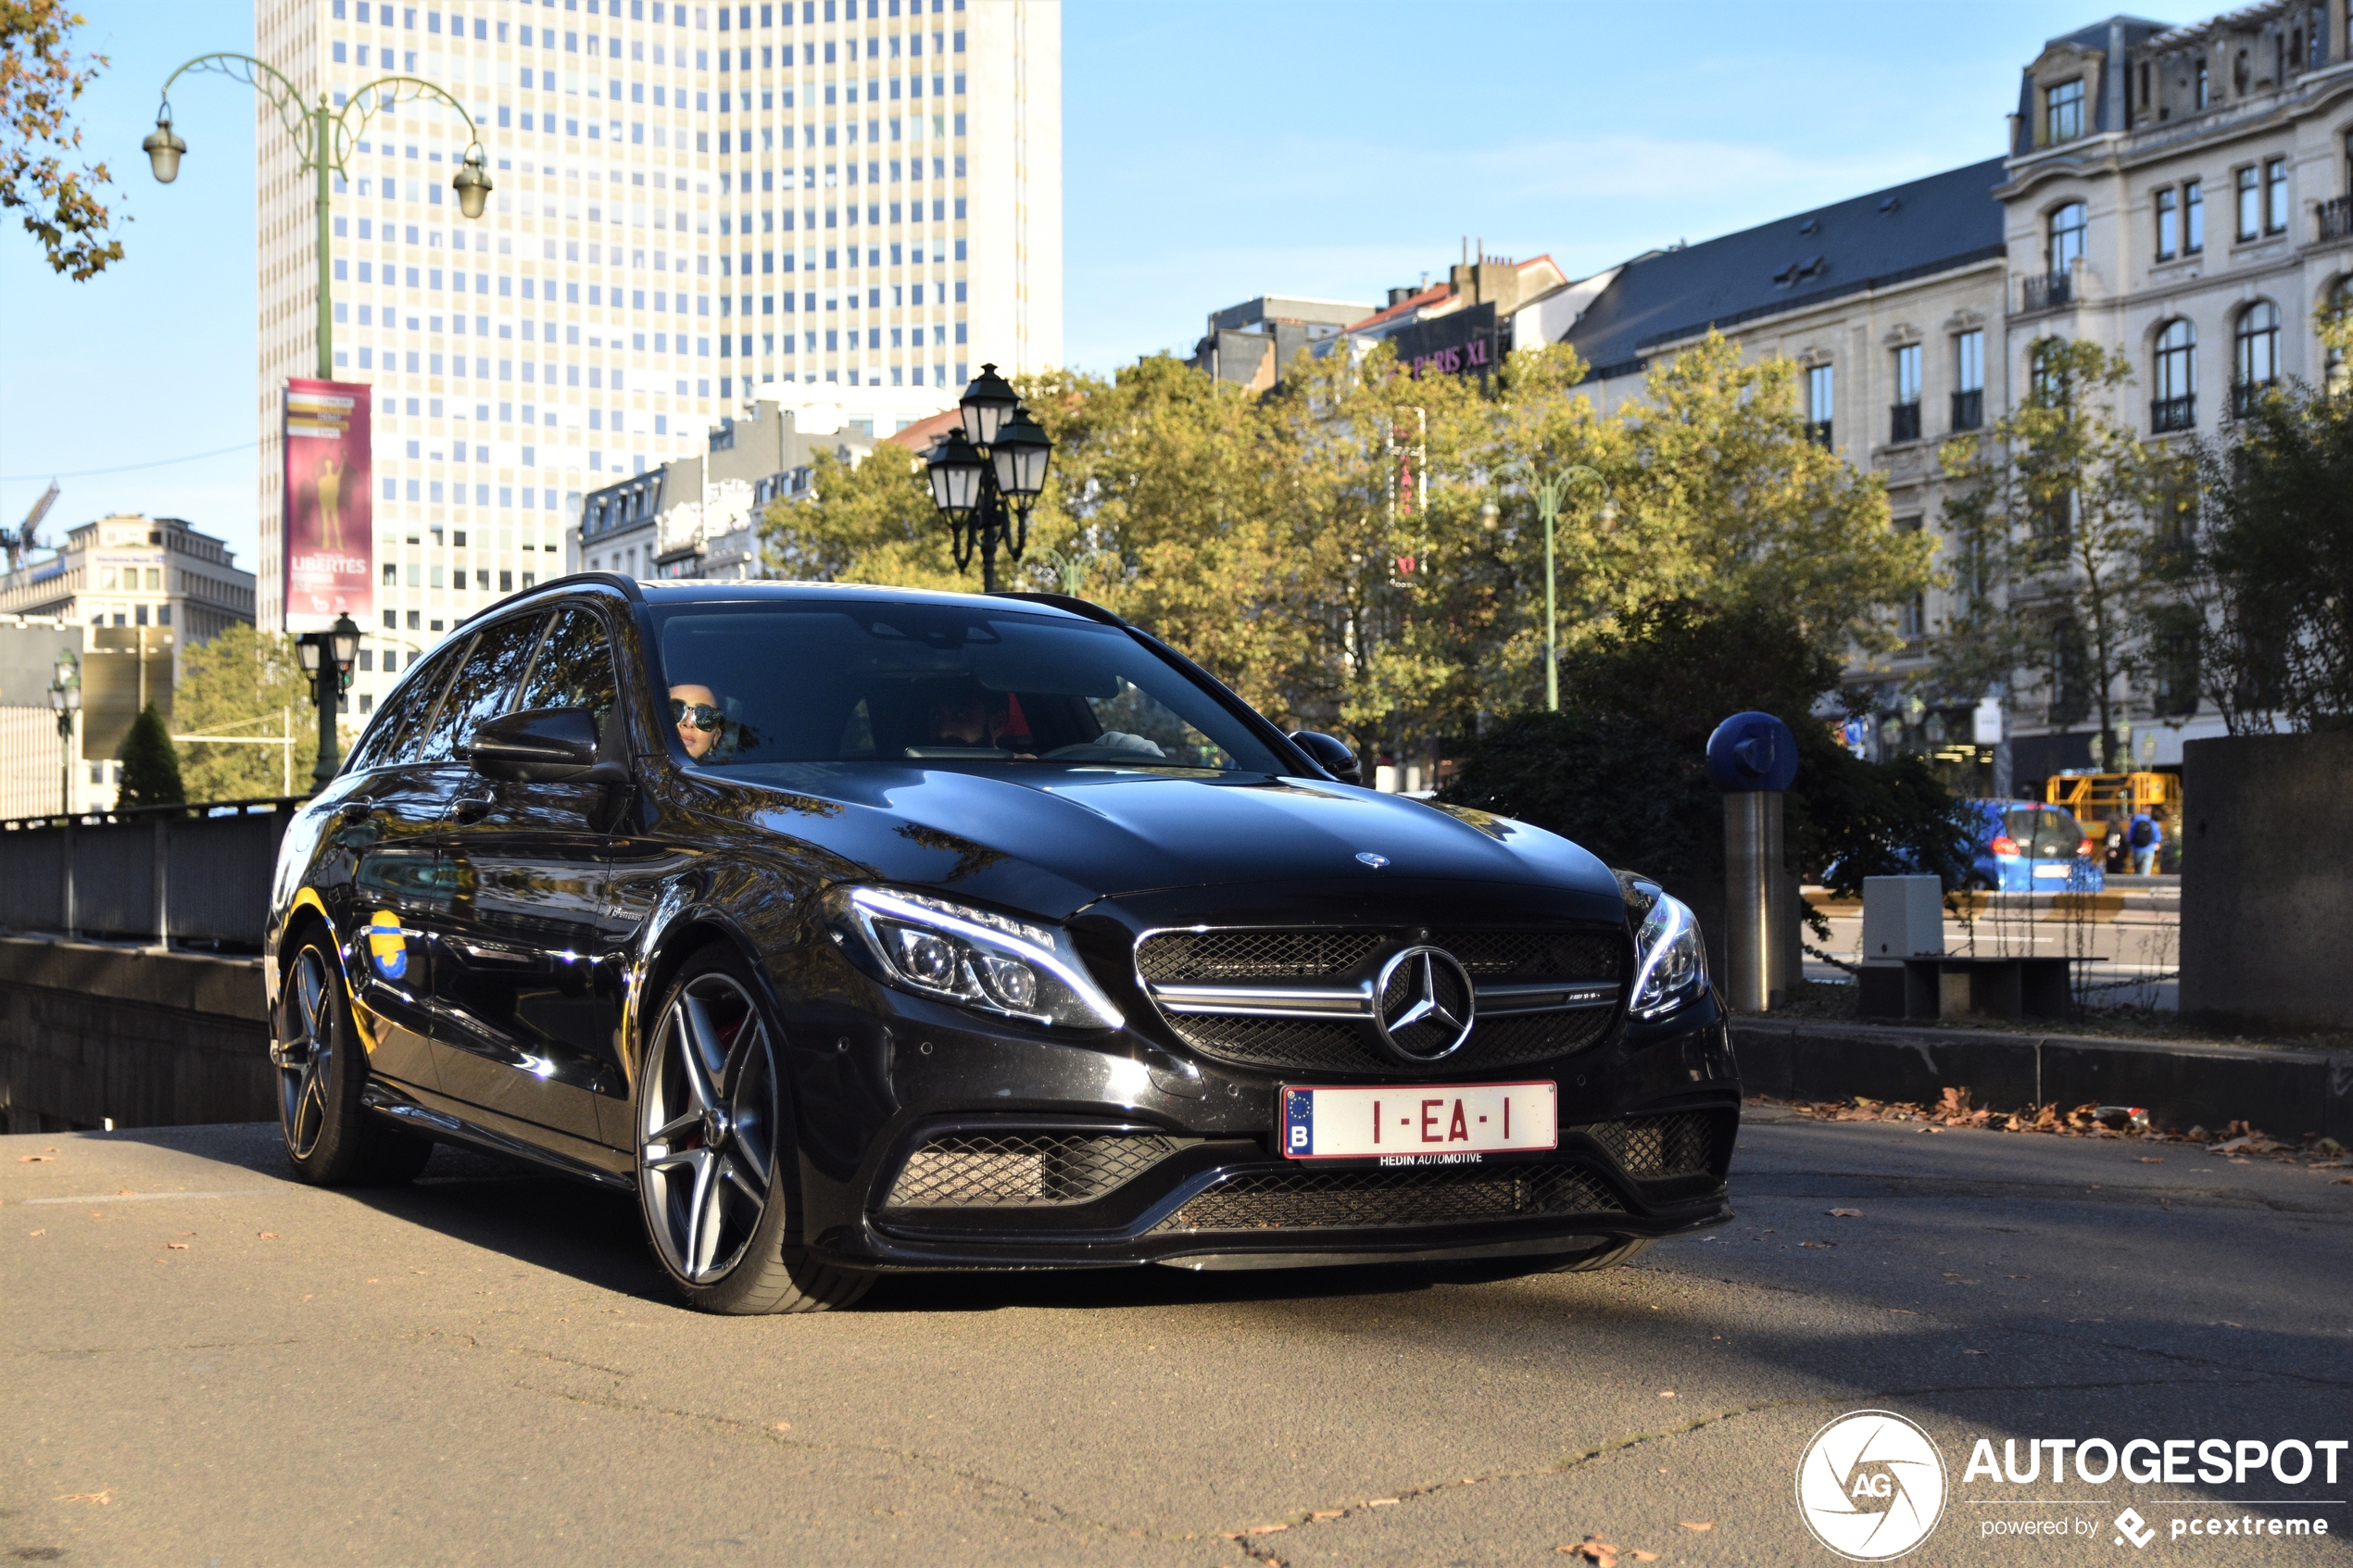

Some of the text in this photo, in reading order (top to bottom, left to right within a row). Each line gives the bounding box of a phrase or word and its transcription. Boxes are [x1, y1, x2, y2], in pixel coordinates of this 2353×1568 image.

[1466, 339, 1488, 368] XL
[291, 556, 367, 575] LIBERTÉS
[1290, 1125, 1308, 1148] B
[1380, 1152, 1482, 1166] HEDIN AUTOMOTIVE
